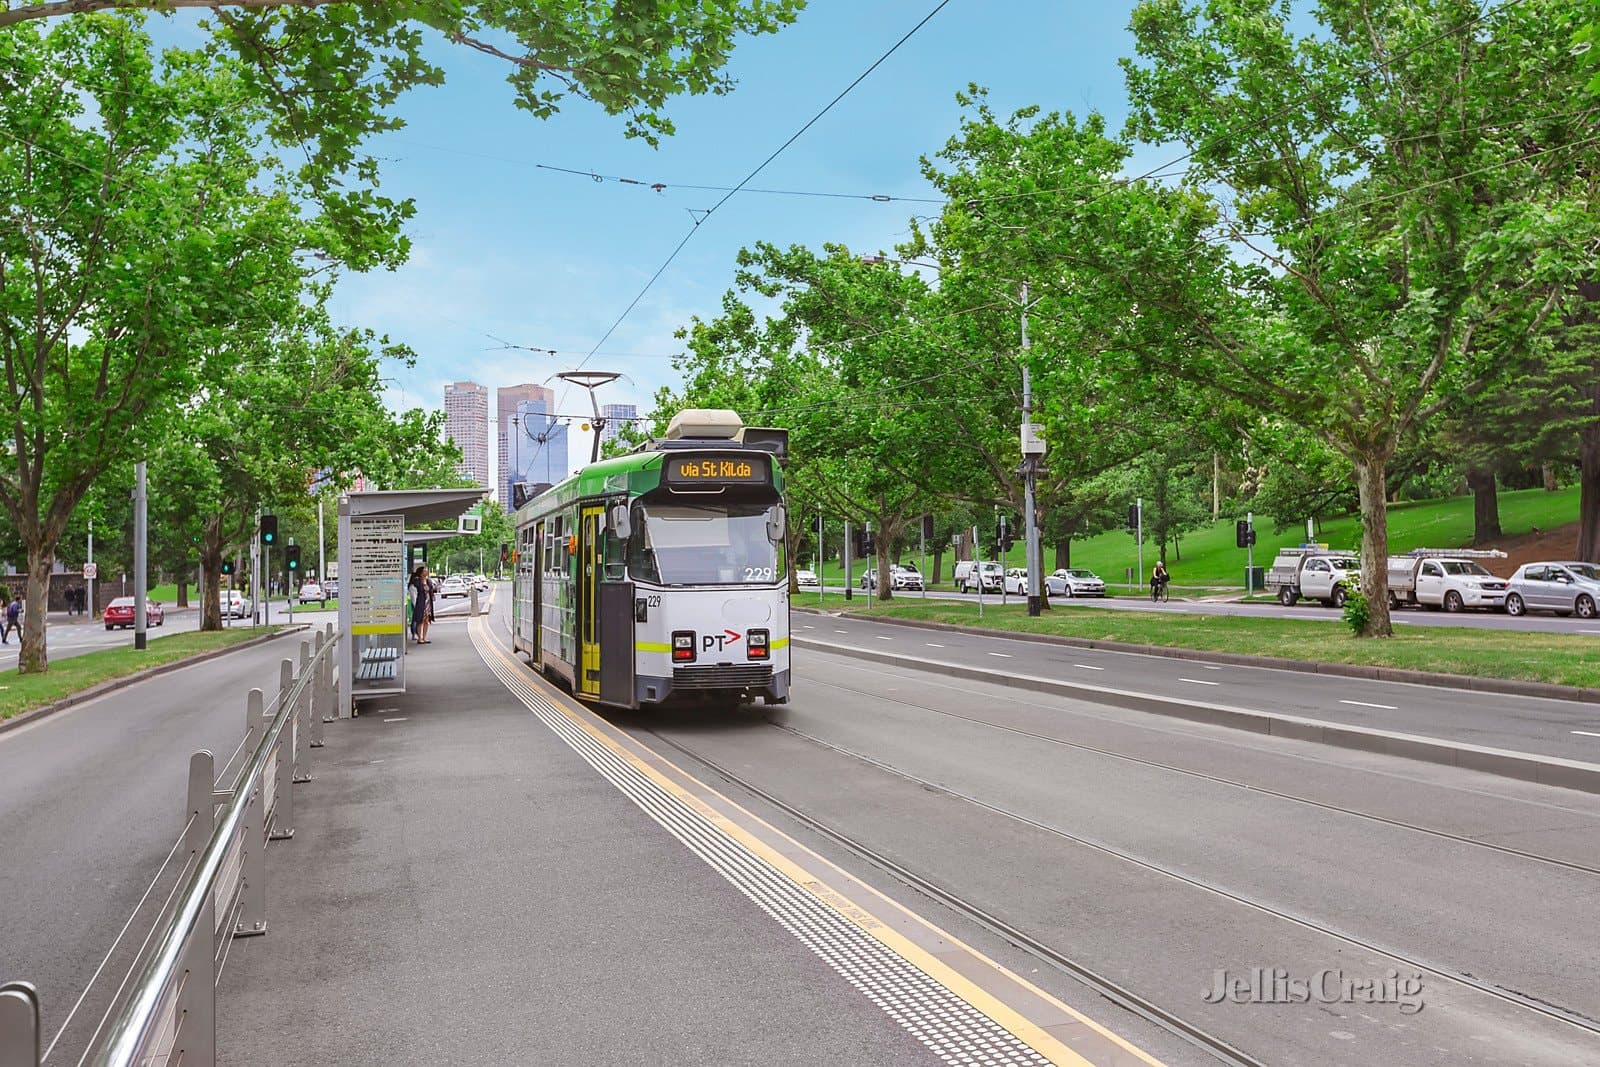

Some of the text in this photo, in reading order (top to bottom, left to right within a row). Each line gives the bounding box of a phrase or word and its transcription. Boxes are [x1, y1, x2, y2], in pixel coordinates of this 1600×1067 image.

[681, 461, 751, 477] via St Kilda
[745, 567, 772, 582] 229
[648, 595, 662, 608] 229
